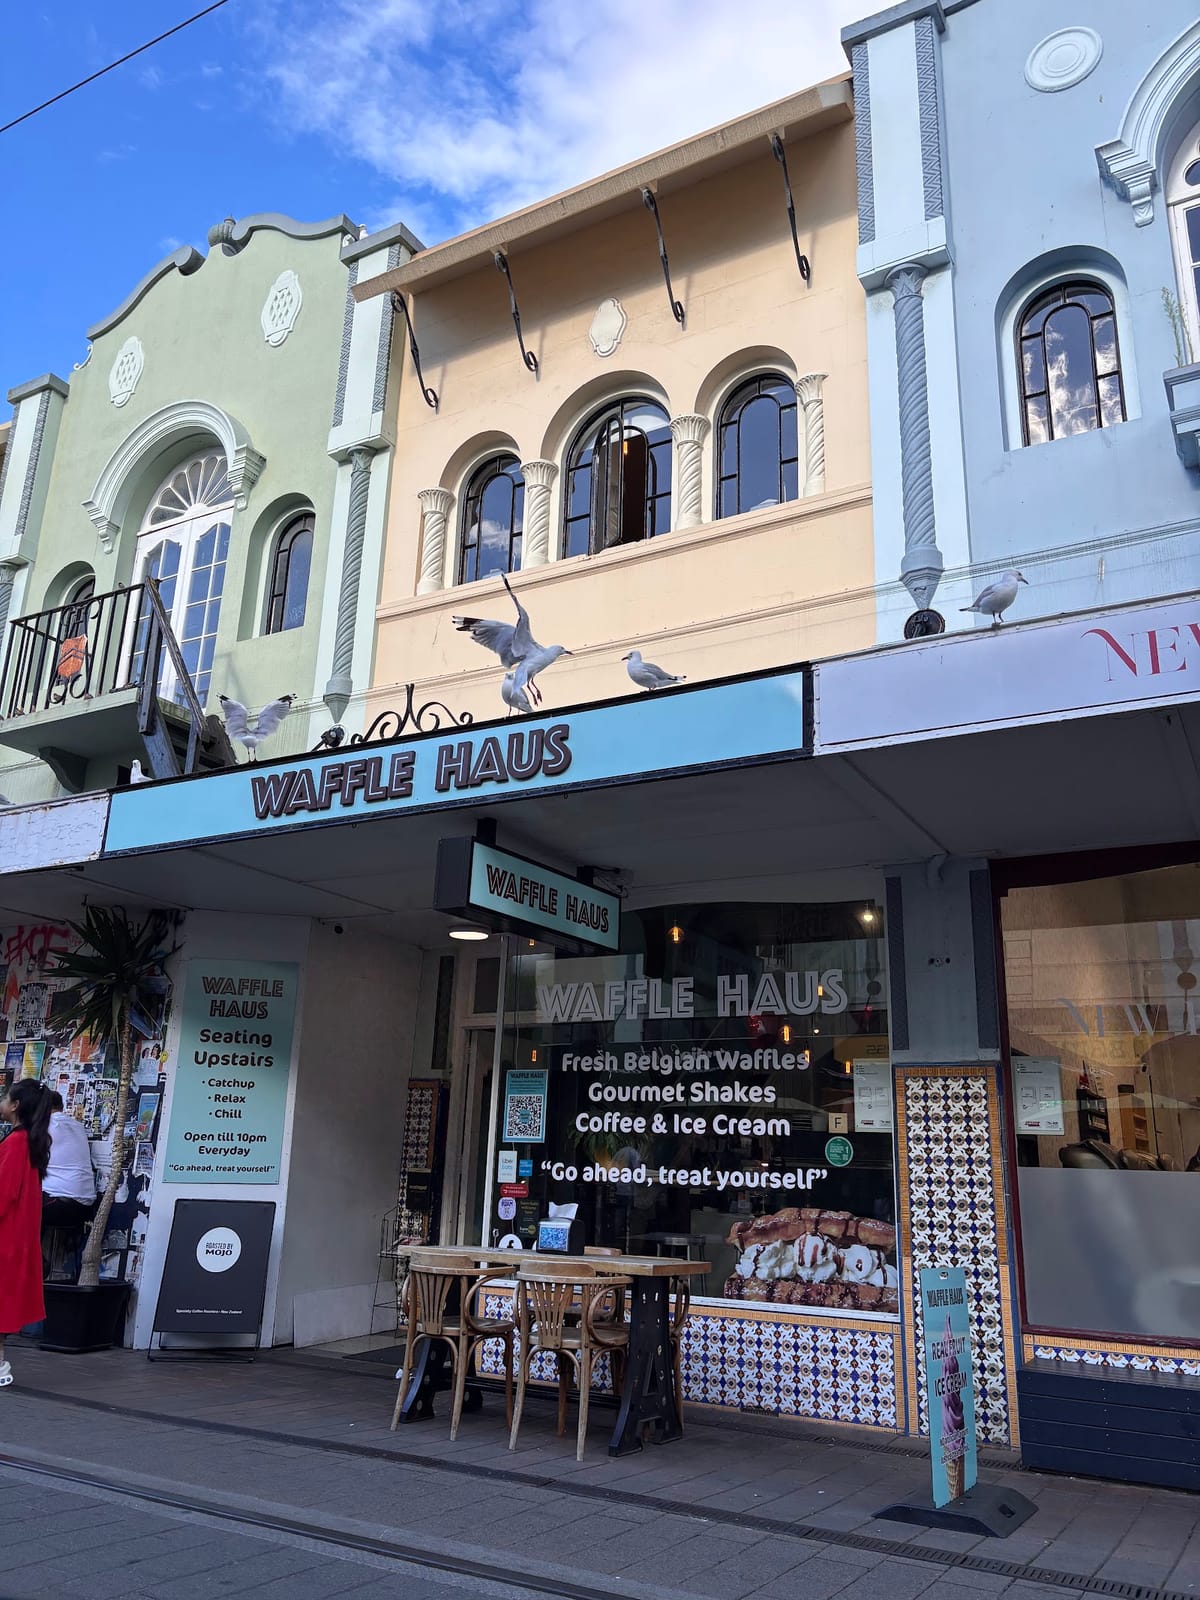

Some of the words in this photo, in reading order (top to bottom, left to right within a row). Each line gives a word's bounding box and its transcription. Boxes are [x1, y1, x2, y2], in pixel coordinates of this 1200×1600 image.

[1080, 622, 1200, 682] NE
[250, 750, 416, 819] WAFFLE
[434, 724, 572, 792] HAUS
[486, 863, 558, 915] WAFFLE
[566, 893, 609, 933] HAUS
[202, 976, 284, 998] WAFFLE
[536, 976, 695, 1023] WAFFLE
[717, 968, 848, 1018] HAUS
[209, 1000, 269, 1019] HAUS
[199, 1028, 273, 1048] Seating
[193, 1050, 274, 1069] Upstairs
[561, 1051, 618, 1073] Fresh
[624, 1051, 710, 1076] Belgian
[716, 1048, 810, 1072] Waffles
[208, 1078, 255, 1089] Catchup
[588, 1081, 685, 1103] Gourmet
[690, 1081, 777, 1103] Shakes
[214, 1093, 246, 1104] Relax
[214, 1108, 242, 1119] Chill
[575, 1112, 646, 1134] Coffee
[651, 1113, 668, 1133] &
[673, 1113, 706, 1135] Ice
[712, 1114, 791, 1136] Cream
[183, 1131, 215, 1143] Open
[217, 1131, 234, 1142] till
[236, 1132, 267, 1144] 10pm
[198, 1145, 251, 1157] Everyday
[186, 1164, 214, 1173] ahead,
[215, 1164, 235, 1172] treat
[236, 1165, 275, 1174] yourself”
[541, 1160, 578, 1181] “Go
[582, 1161, 652, 1188] ahead,
[658, 1165, 711, 1186] treat
[716, 1167, 828, 1191] yourself”
[926, 1288, 949, 1308] WAFFLE
[931, 1341, 948, 1361] REAL
[949, 1336, 966, 1357] FRUIT
[934, 1376, 946, 1398] ICE
[946, 1371, 968, 1395] CREAM
